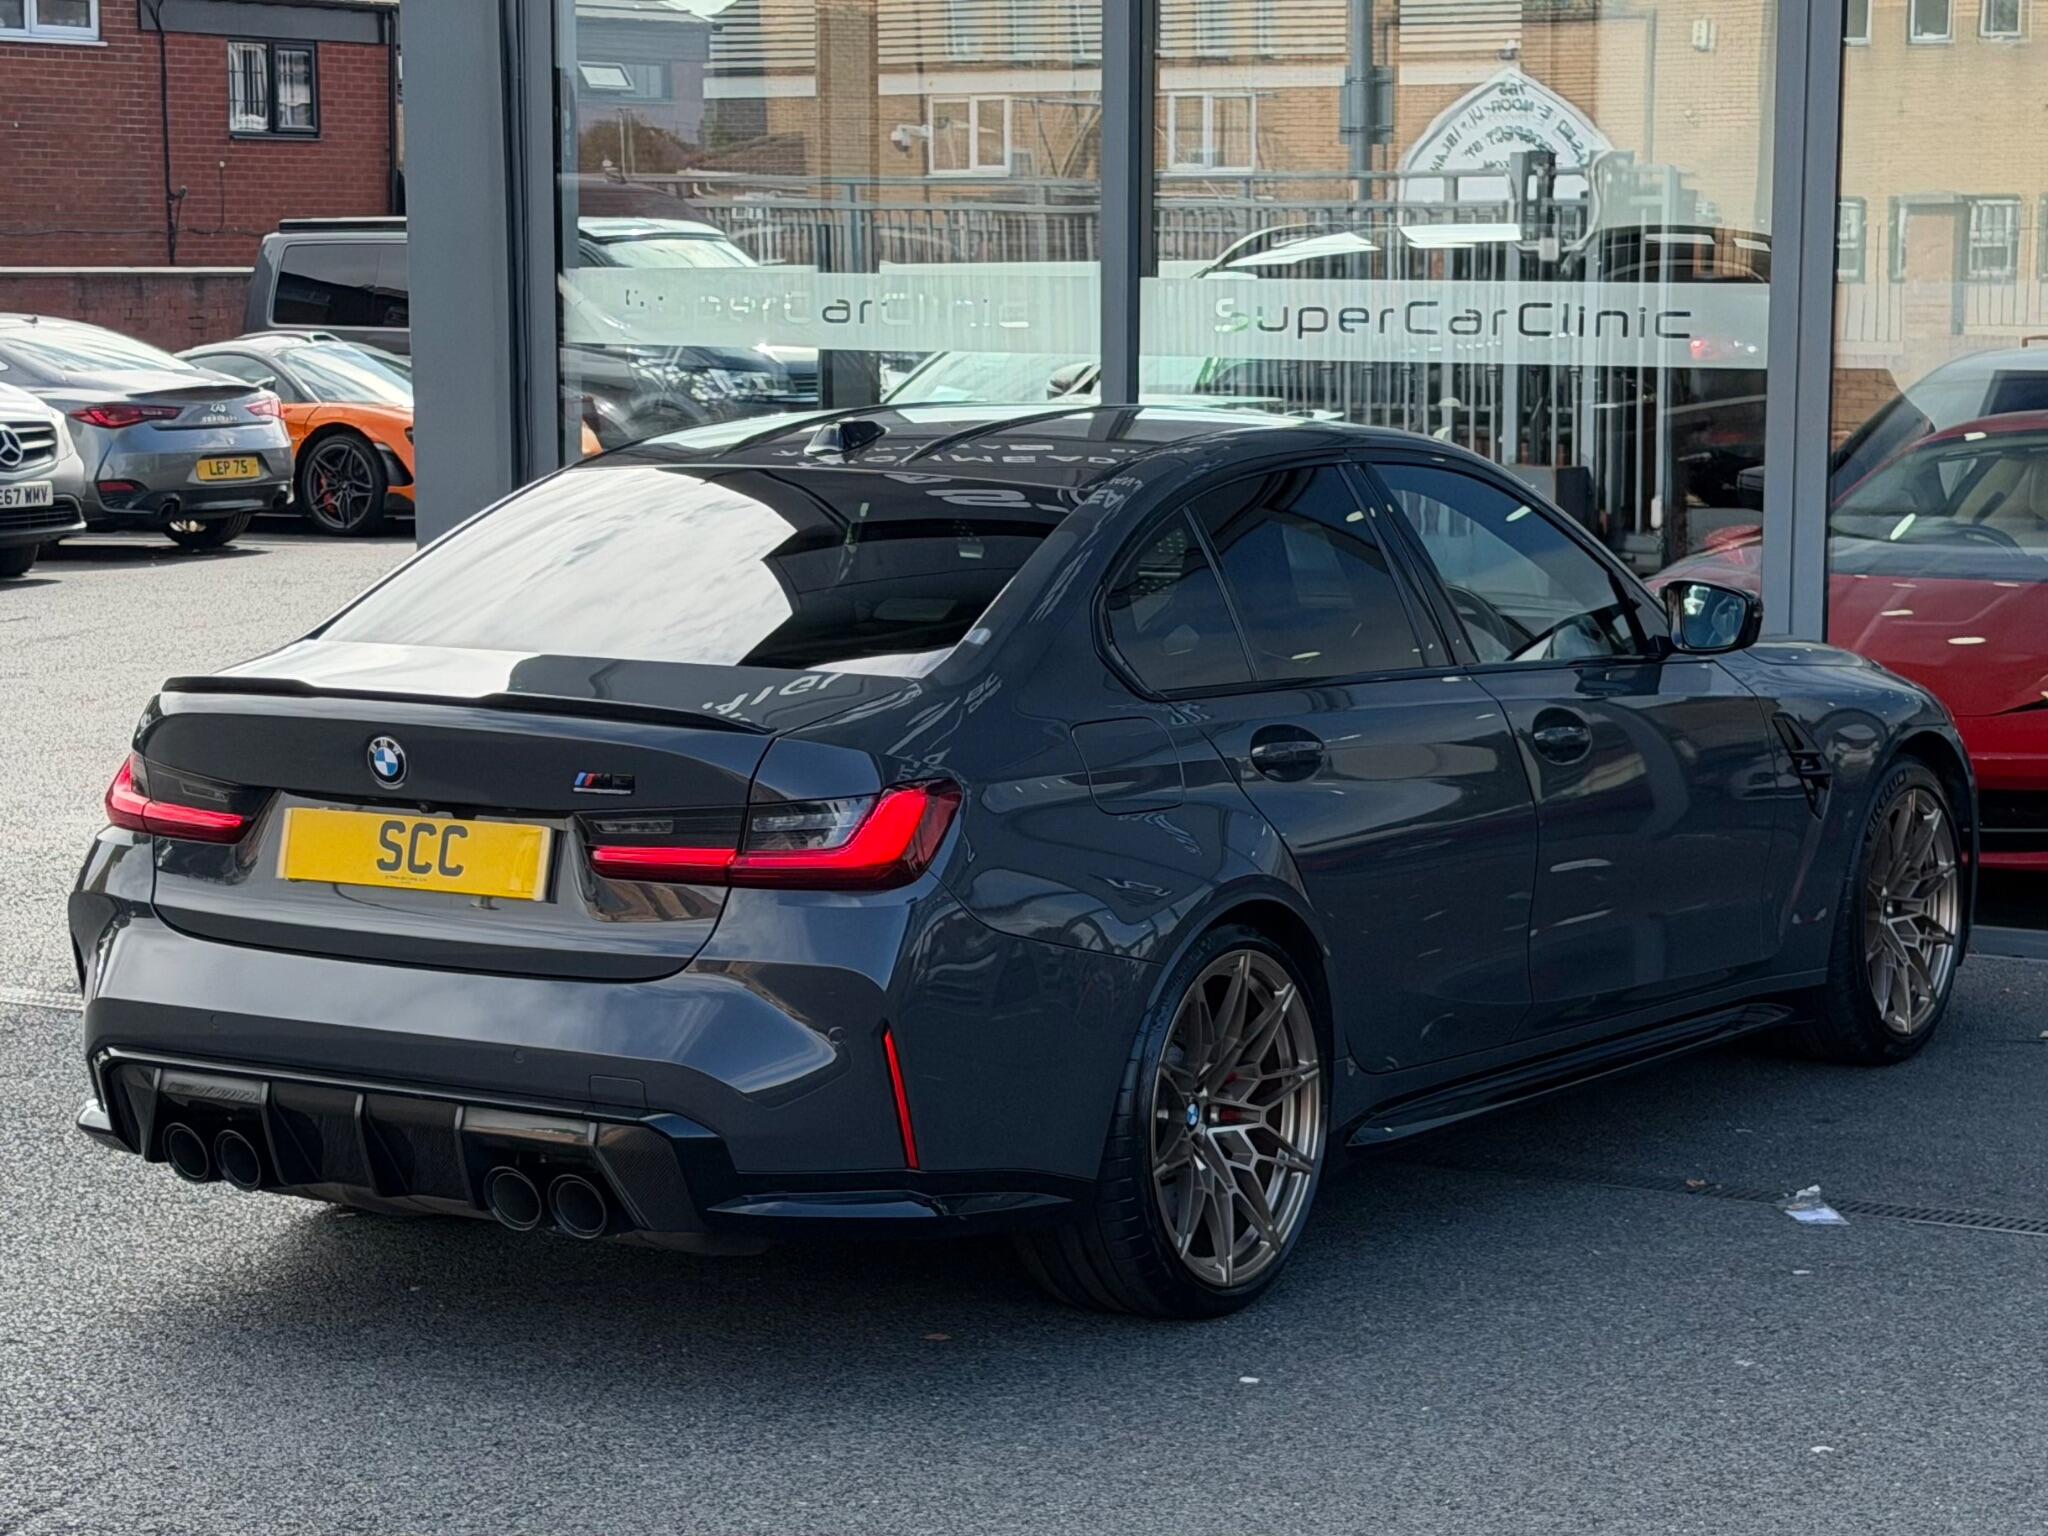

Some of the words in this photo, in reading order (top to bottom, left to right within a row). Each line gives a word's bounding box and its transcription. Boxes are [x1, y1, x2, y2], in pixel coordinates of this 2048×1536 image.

[1214, 297, 1692, 340] SuperCarClinic
[208, 460, 230, 476] LEP
[233, 459, 248, 475] 75
[377, 820, 468, 877] SCC
